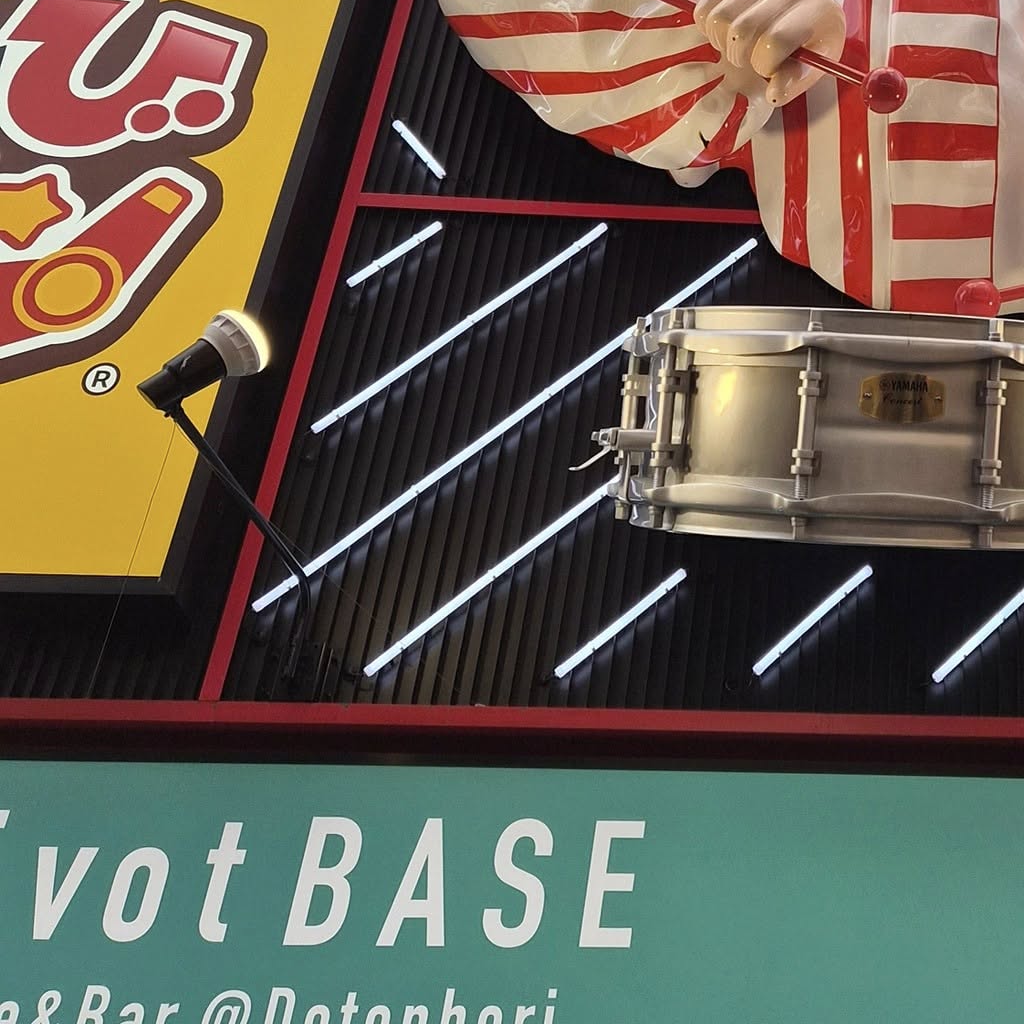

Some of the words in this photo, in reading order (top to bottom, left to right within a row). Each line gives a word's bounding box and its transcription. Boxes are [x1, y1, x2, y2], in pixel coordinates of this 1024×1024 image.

[891, 379, 928, 393] YAMAHA
[0, 809, 246, 943] vot
[283, 816, 646, 949] BASE
